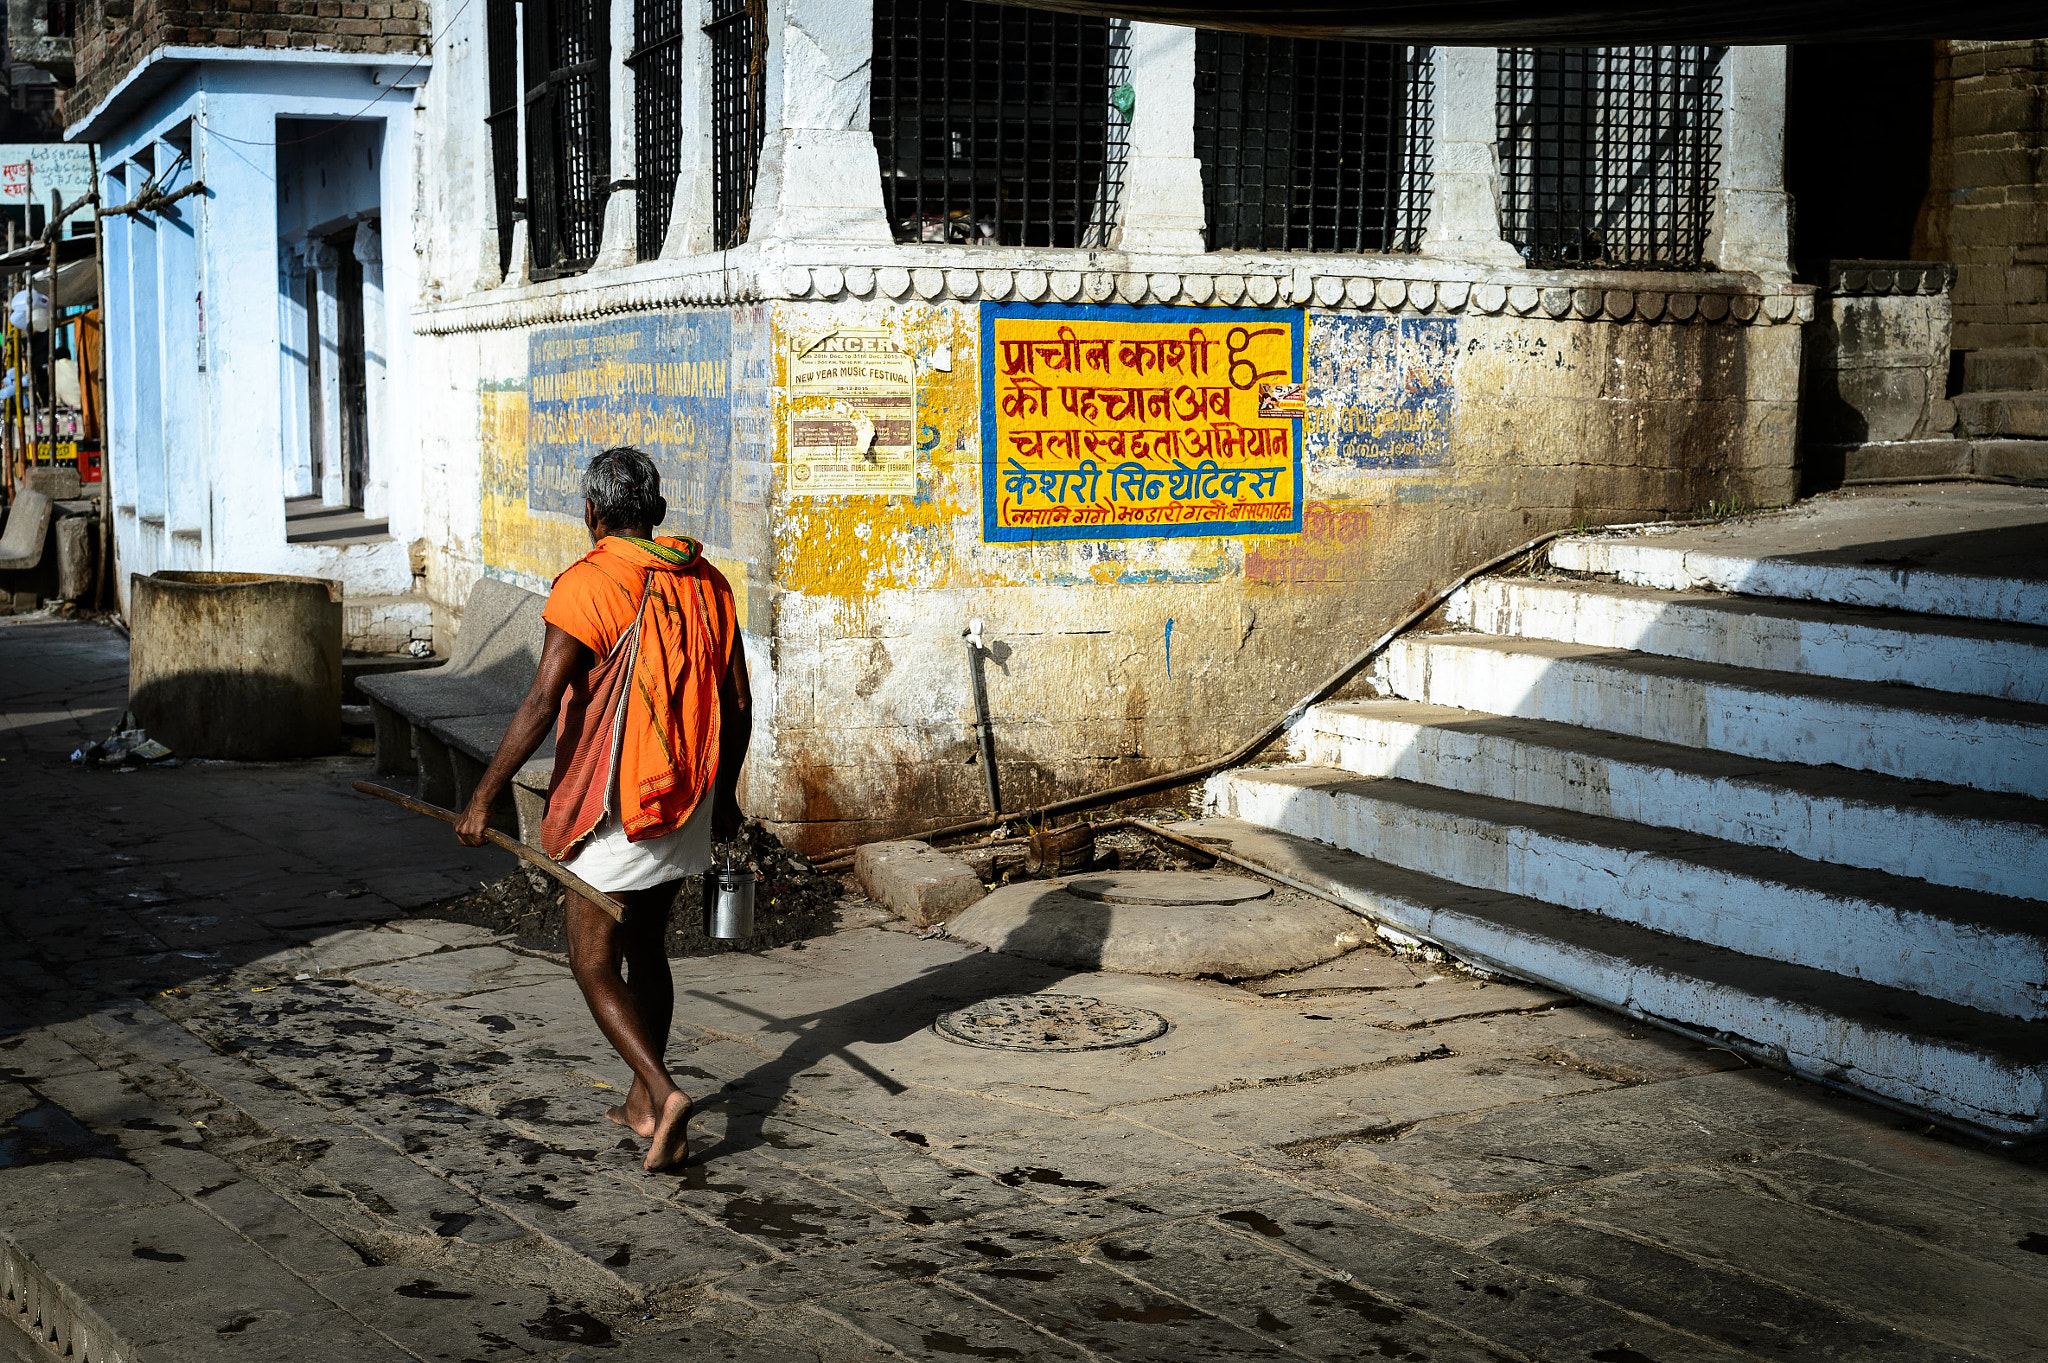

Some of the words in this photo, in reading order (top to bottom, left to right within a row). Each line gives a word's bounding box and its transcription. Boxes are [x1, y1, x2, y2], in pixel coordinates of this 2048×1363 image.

[1000, 326, 1115, 376] प्राचीन
[1118, 327, 1220, 378] काशी
[627, 362, 653, 395] PUJA
[656, 359, 727, 399] MANDAPAM
[795, 371, 814, 384] NEW
[816, 367, 838, 380] YEAR
[869, 368, 909, 384] FESTIVAL
[1057, 386, 1173, 427] पहचान
[1172, 385, 1233, 421] अब
[1008, 430, 1081, 460] चला
[1179, 422, 1288, 459] अभियान
[851, 464, 866, 472] MUSIC
[1003, 457, 1103, 505] केशरी
